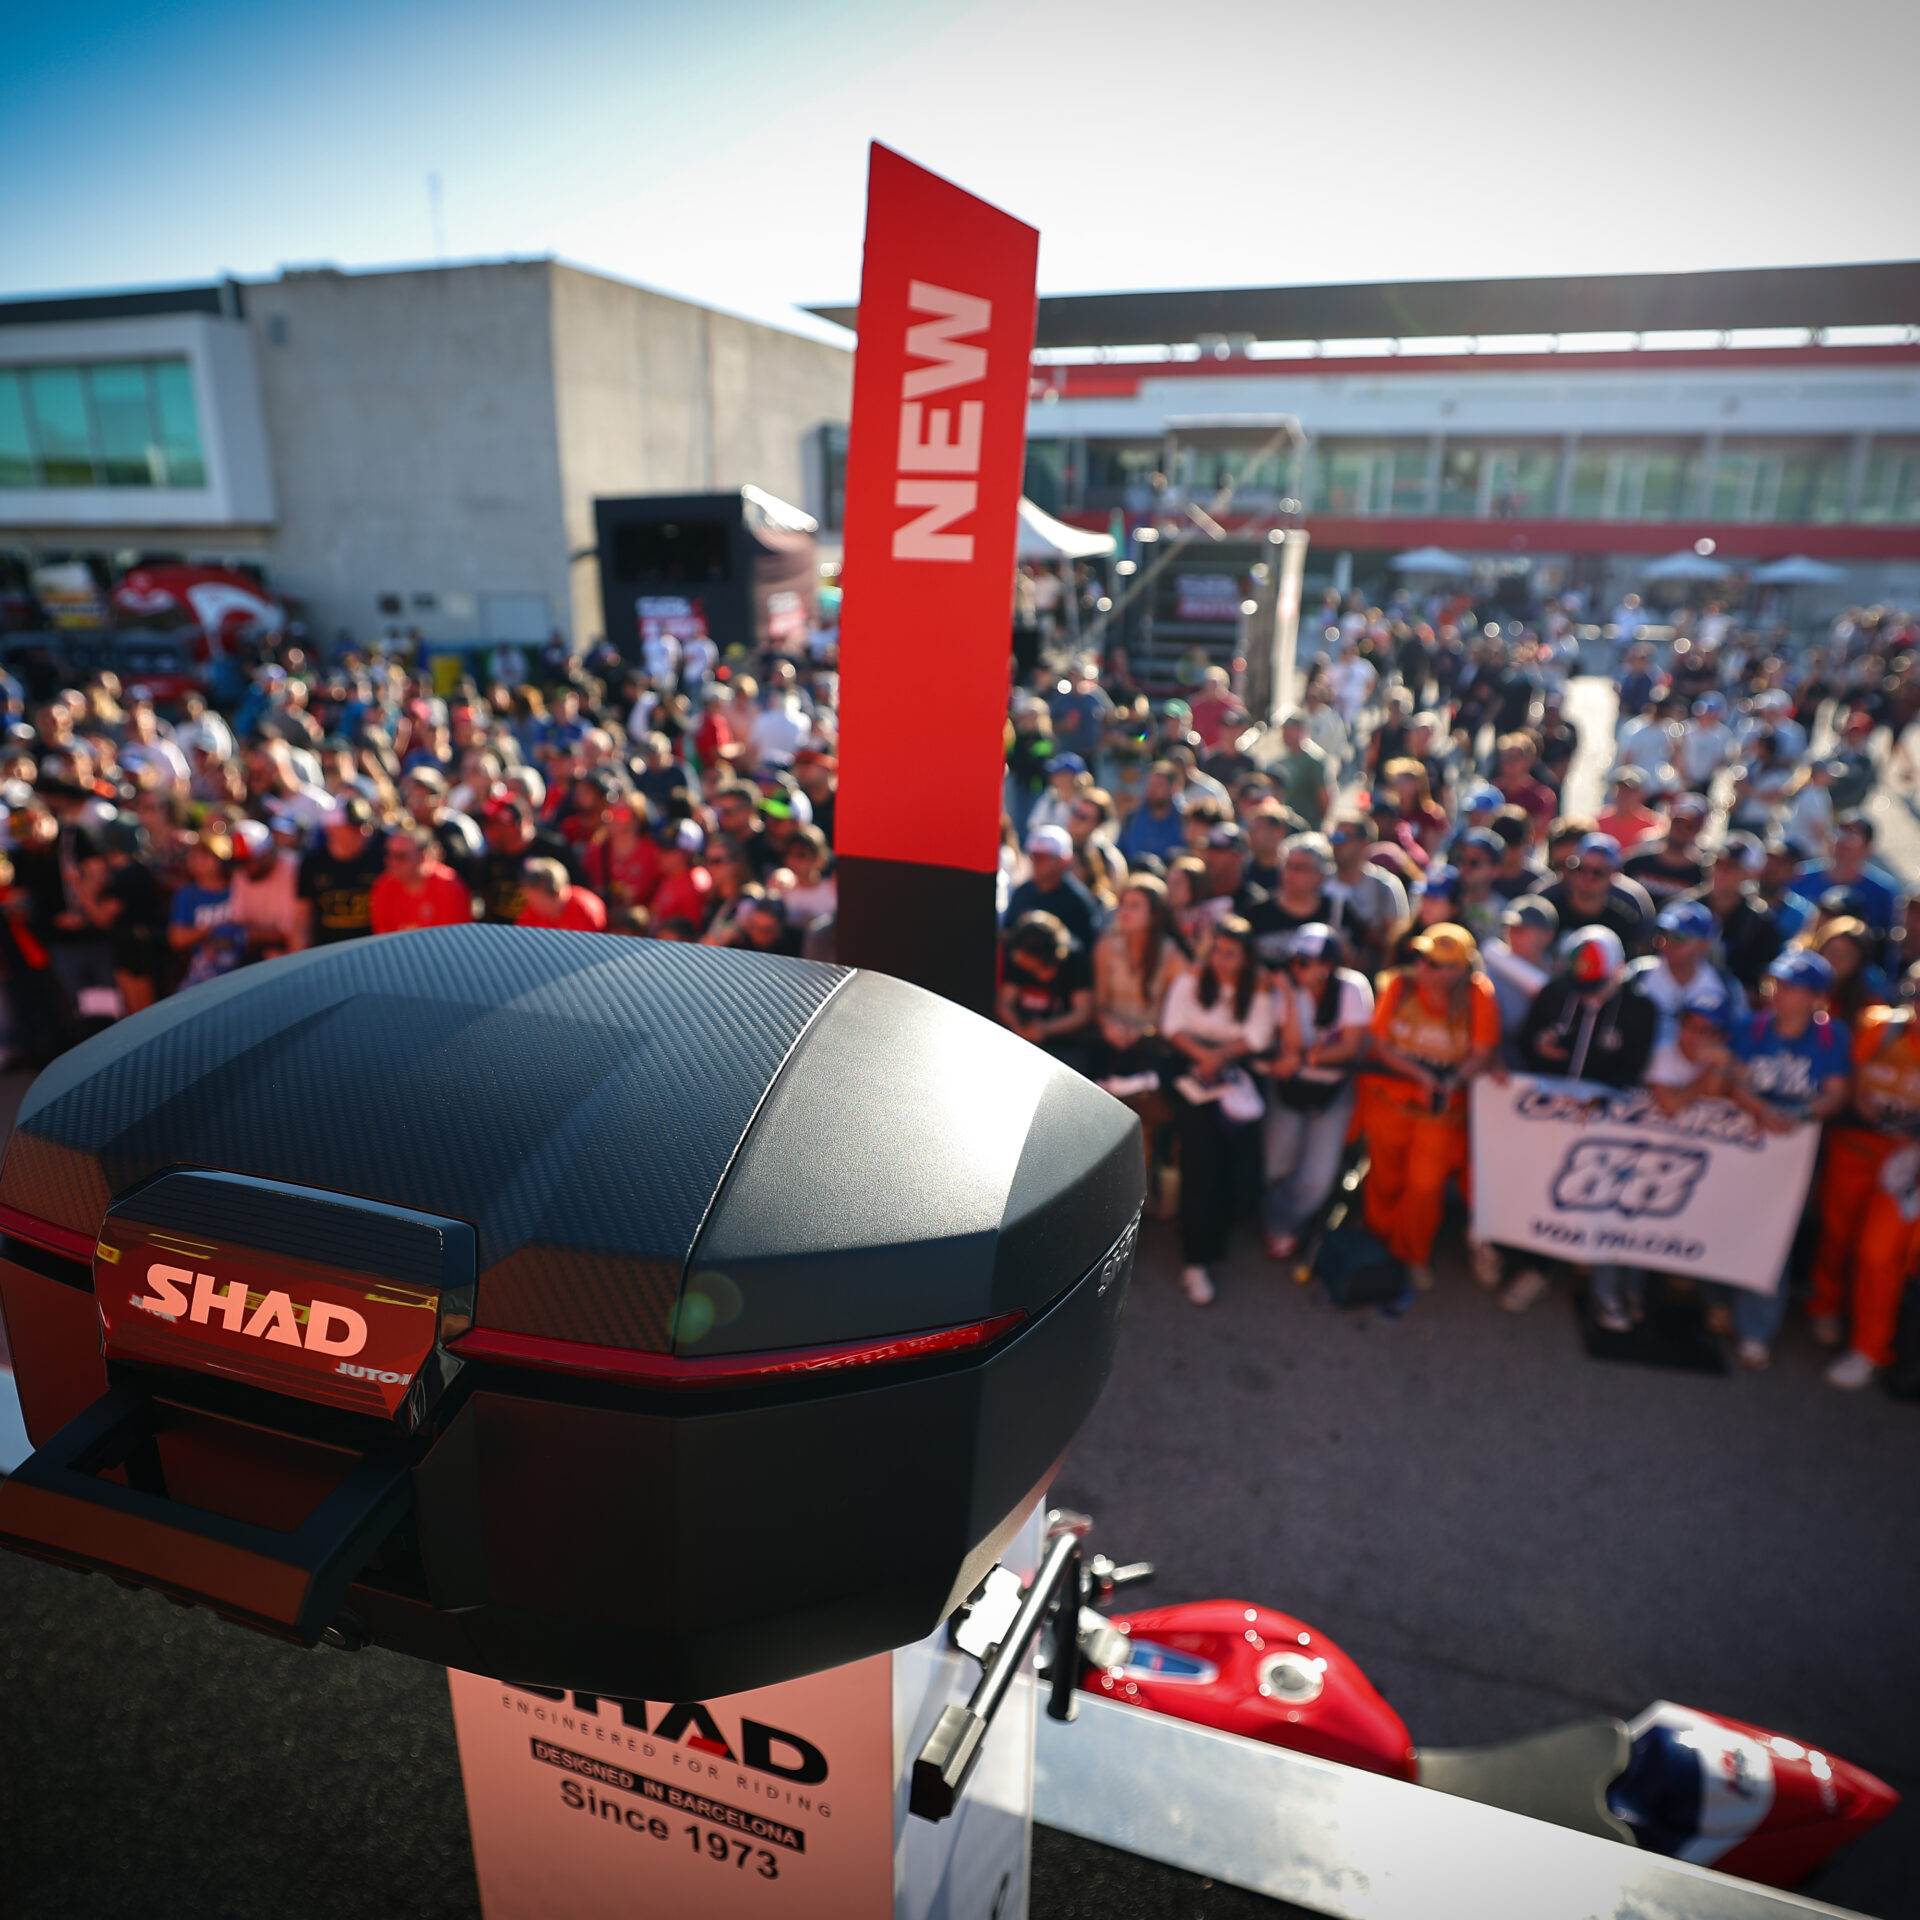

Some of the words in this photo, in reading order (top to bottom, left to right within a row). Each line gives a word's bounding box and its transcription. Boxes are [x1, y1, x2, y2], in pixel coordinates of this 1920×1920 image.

[892, 279, 991, 562] NEW
[142, 1263, 368, 1357] SHAD
[502, 1695, 657, 1758] ENGINEERED
[672, 1752, 720, 1781] FOR
[736, 1774, 832, 1819] RIDING
[535, 1744, 634, 1789] DESIGNED
[643, 1780, 664, 1801] IN
[668, 1788, 799, 1849] BARCELONA
[560, 1778, 670, 1842] Since
[685, 1825, 779, 1881] 1973
